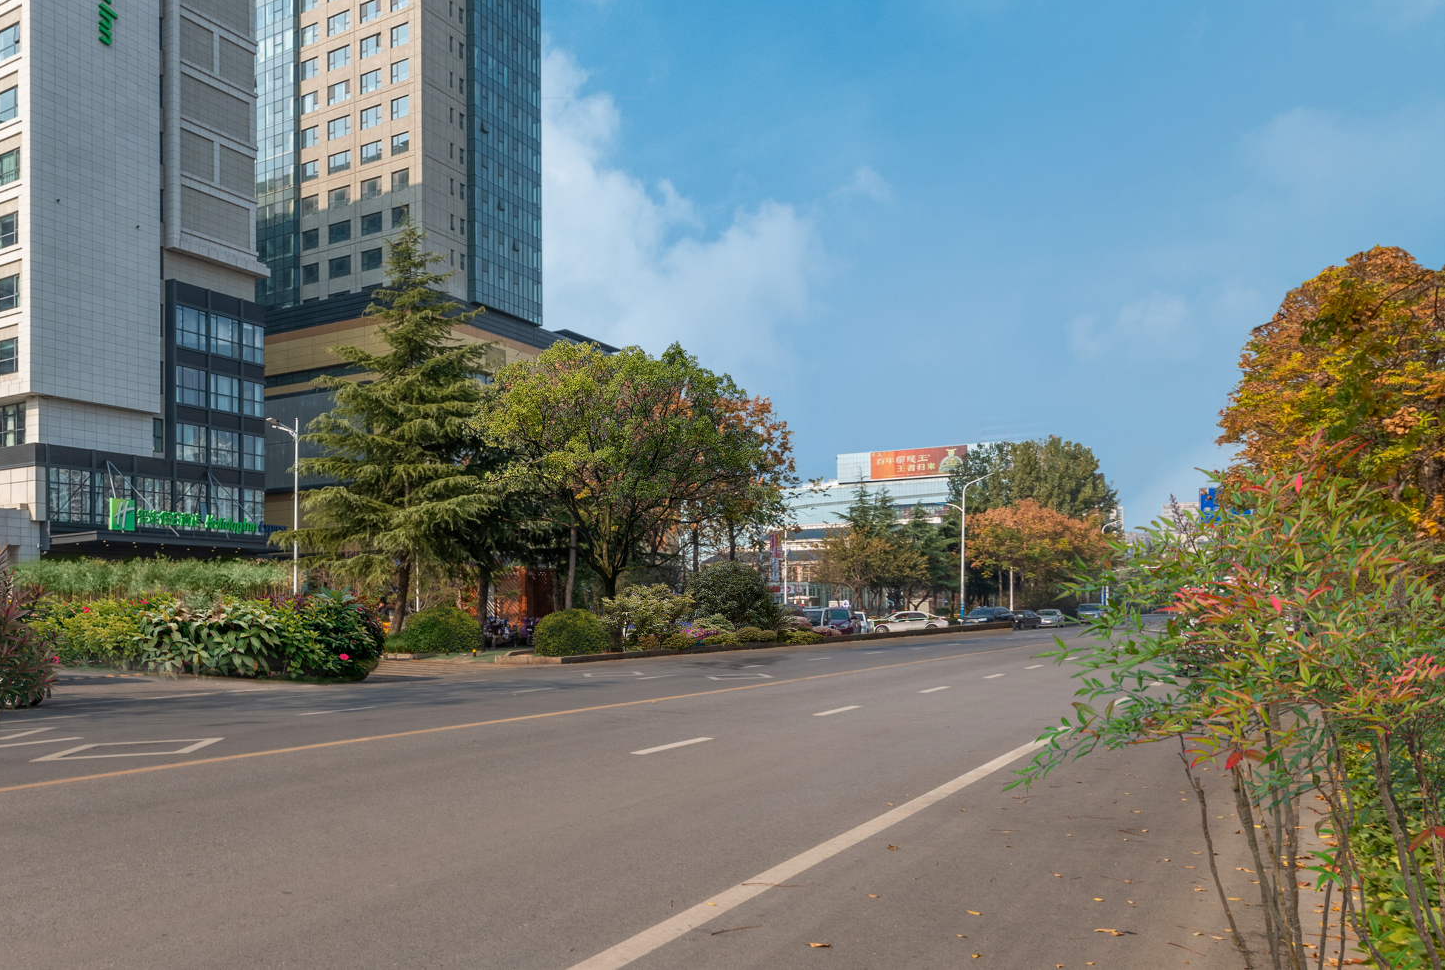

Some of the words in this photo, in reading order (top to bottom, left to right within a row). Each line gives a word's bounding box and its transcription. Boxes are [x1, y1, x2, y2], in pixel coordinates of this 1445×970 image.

[98, 2, 119, 46] Inn
[897, 462, 936, 473] 王者归来
[204, 514, 243, 534] Holiday
[242, 517, 258, 533] Inn
